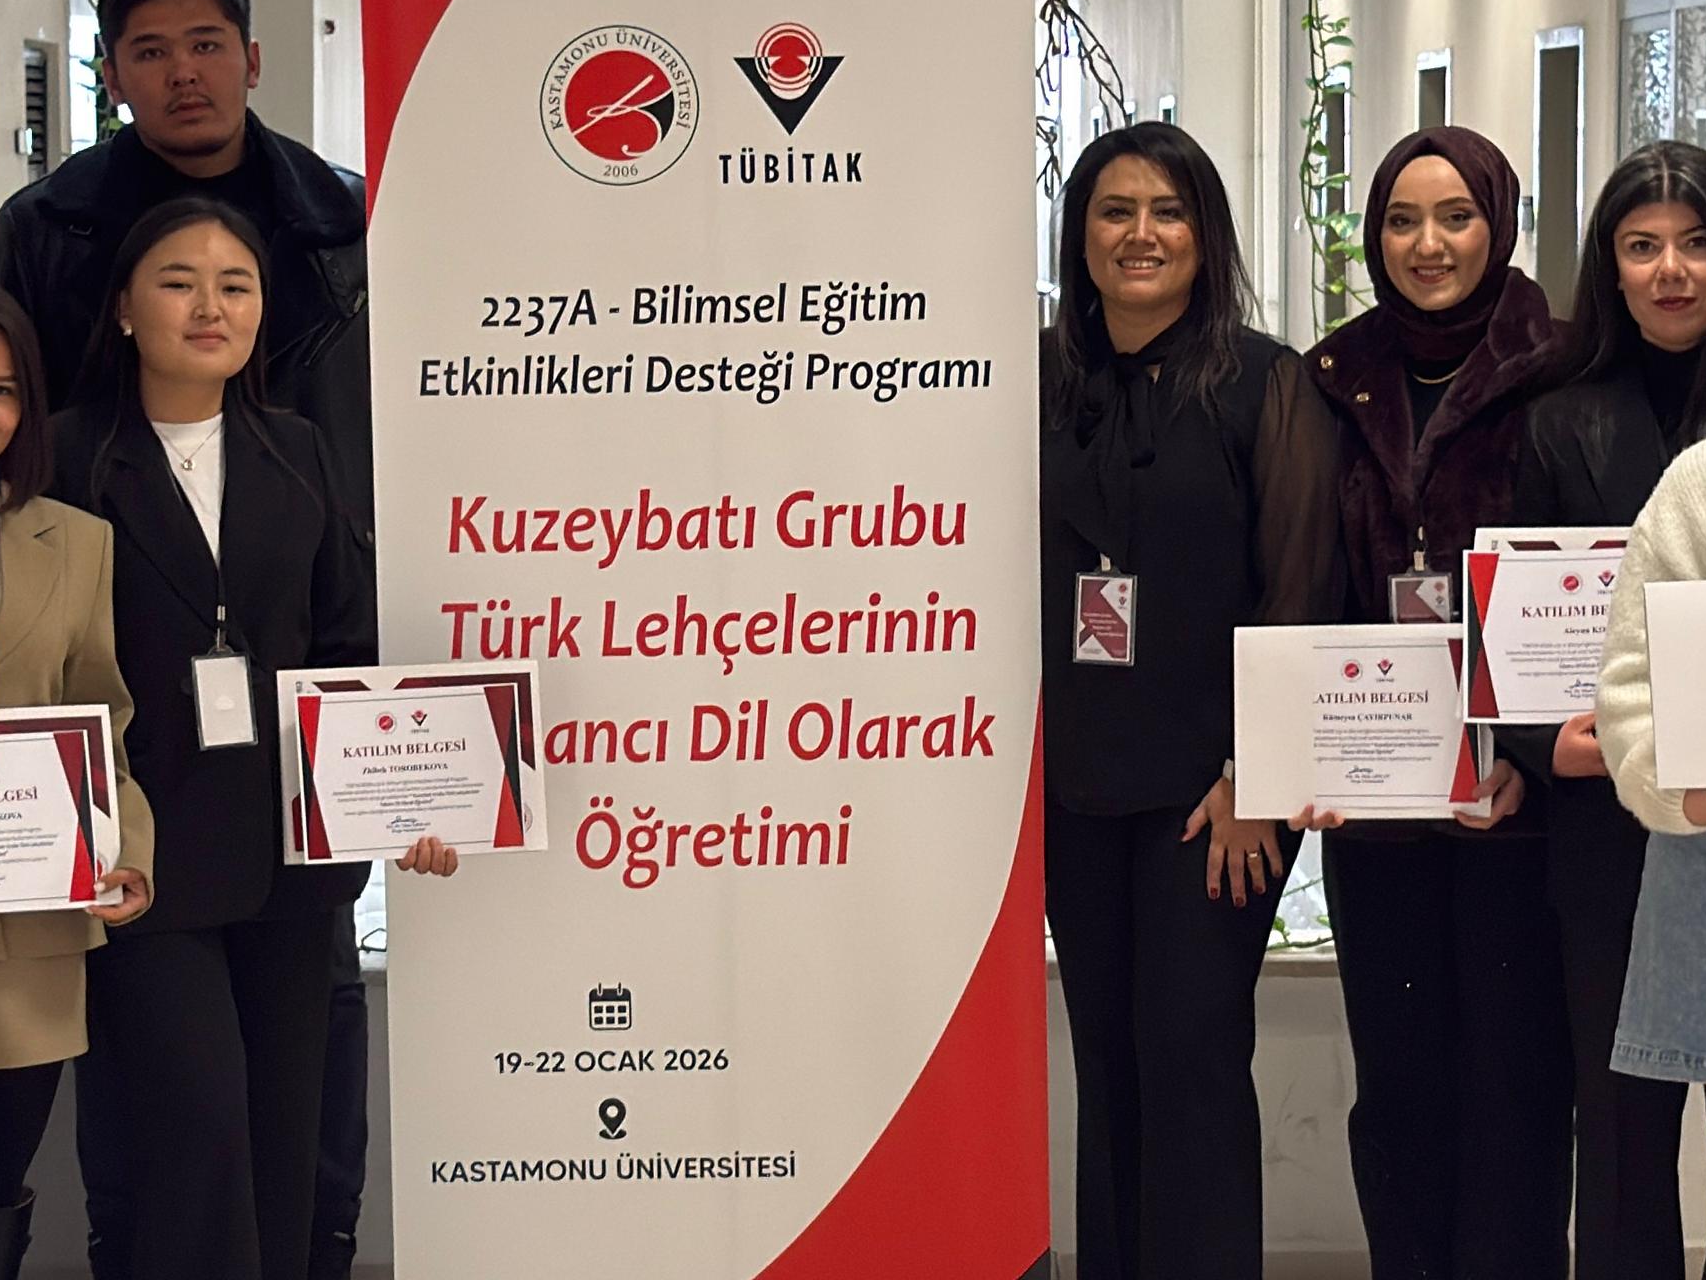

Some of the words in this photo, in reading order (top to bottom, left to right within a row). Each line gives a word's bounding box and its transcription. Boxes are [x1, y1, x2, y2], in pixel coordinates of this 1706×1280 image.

[549, 31, 609, 131] KASTAMONU
[615, 27, 692, 129] ÜNİVERSİTESİ
[603, 163, 639, 178] 2006
[718, 146, 863, 185] TÜBİTAK
[481, 287, 595, 336] 2237A
[631, 282, 787, 325] Bilimsel
[799, 280, 928, 335] Eğitim
[418, 353, 634, 398] Etkinlikleri
[646, 350, 794, 404] Desteği
[804, 354, 993, 403] Programı
[448, 488, 756, 569] Kuzeybatı
[776, 484, 968, 550] Grubu
[441, 596, 582, 661] Türk
[602, 591, 978, 675] Lehçelerinin
[1521, 606, 1586, 618] KATILIM
[1313, 692, 1366, 704] ATILIM
[1370, 690, 1429, 704] BELGESİ
[343, 744, 402, 759] KATILIM
[406, 737, 466, 755] BELGESİ
[544, 717, 668, 763] ancı
[689, 699, 770, 762] Dil
[787, 695, 997, 762] Olarak
[575, 796, 853, 889] Öğretimi
[494, 1052, 566, 1074] 19-22
[574, 1049, 655, 1073] OCAK
[664, 1048, 730, 1071] 2026
[431, 1158, 607, 1183] KASTAMONU
[616, 1150, 796, 1179] ÜNİVERSİTESİ
